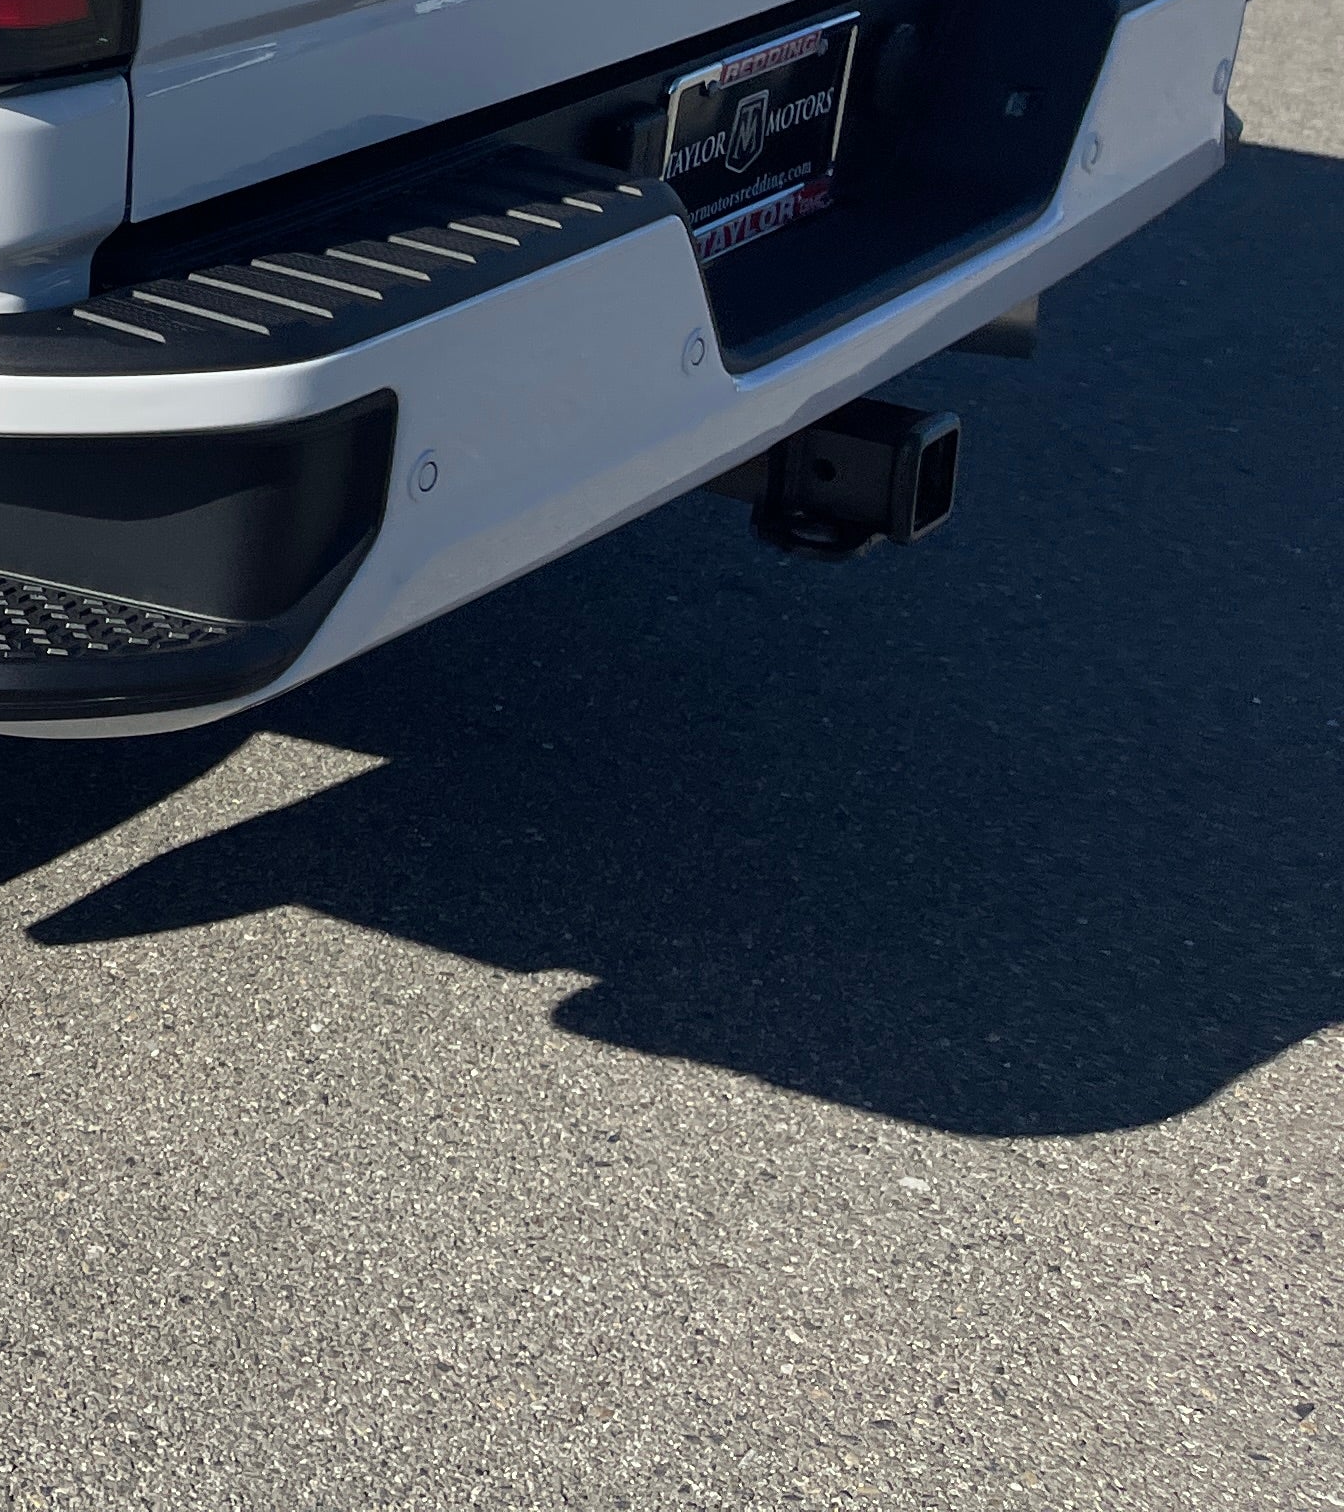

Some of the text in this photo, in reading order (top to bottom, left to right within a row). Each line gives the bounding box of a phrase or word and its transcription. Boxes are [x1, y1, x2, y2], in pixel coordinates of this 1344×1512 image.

[724, 33, 819, 84] REDDING
[665, 86, 835, 180] TAYLOR MOTORS
[696, 196, 795, 259] TAYLOR
